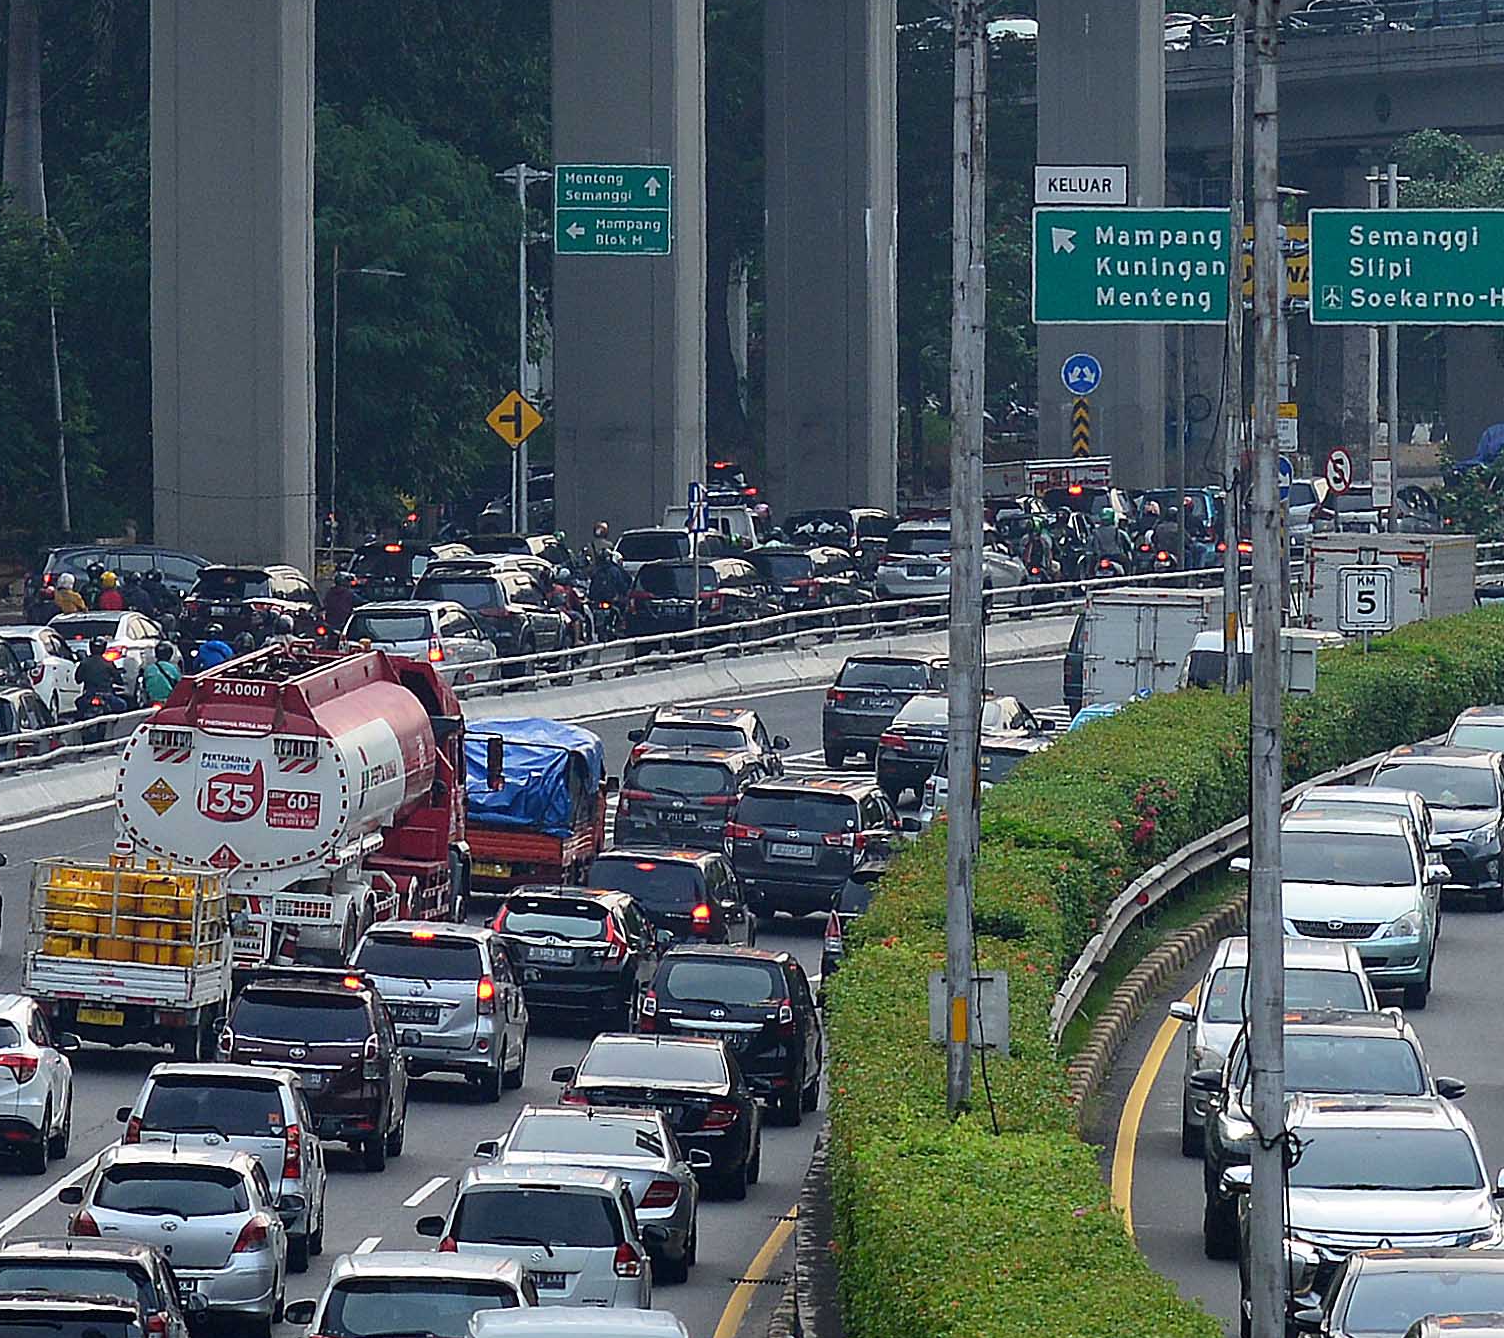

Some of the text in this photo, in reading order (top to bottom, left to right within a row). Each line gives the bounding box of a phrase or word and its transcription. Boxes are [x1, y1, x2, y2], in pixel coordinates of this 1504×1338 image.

[565, 172, 624, 188] Menteng
[1047, 176, 1113, 194] KELUAR
[565, 188, 633, 203] Semanggi
[595, 217, 661, 233] Mampang
[595, 233, 643, 246] Blok M
[1095, 225, 1222, 251] Mampang
[1349, 225, 1480, 251] Semanggi
[1095, 256, 1226, 281] Kuningan
[1349, 255, 1413, 281] Slipi
[1095, 286, 1212, 311] Menteng
[1357, 575, 1376, 587] KM
[1355, 589, 1377, 615] 5
[201, 752, 251, 764] PERTAMINA
[199, 781, 254, 815] 135
[286, 793, 311, 811] 60
